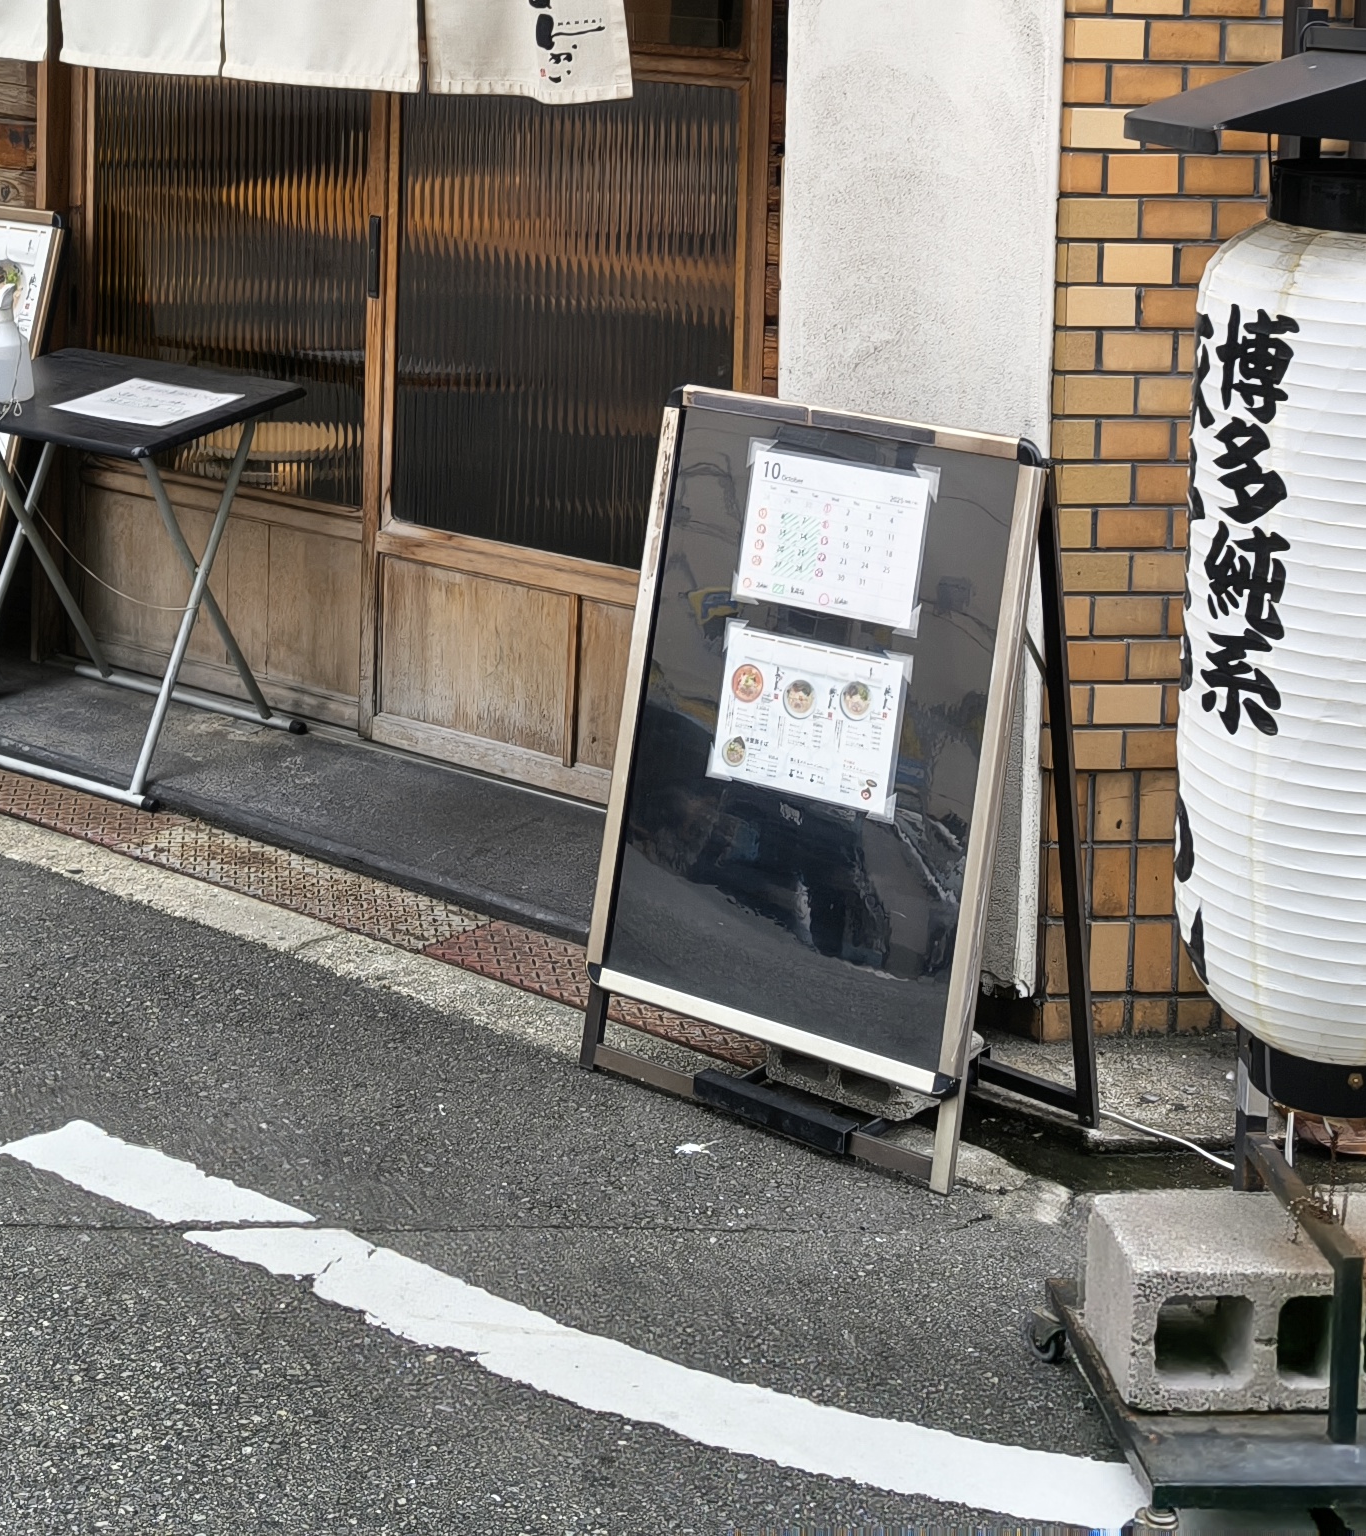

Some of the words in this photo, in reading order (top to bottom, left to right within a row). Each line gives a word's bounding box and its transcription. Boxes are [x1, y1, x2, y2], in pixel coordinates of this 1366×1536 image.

[764, 460, 781, 480] 10
[781, 474, 804, 484] October
[1201, 302, 1300, 737] 博多純系
